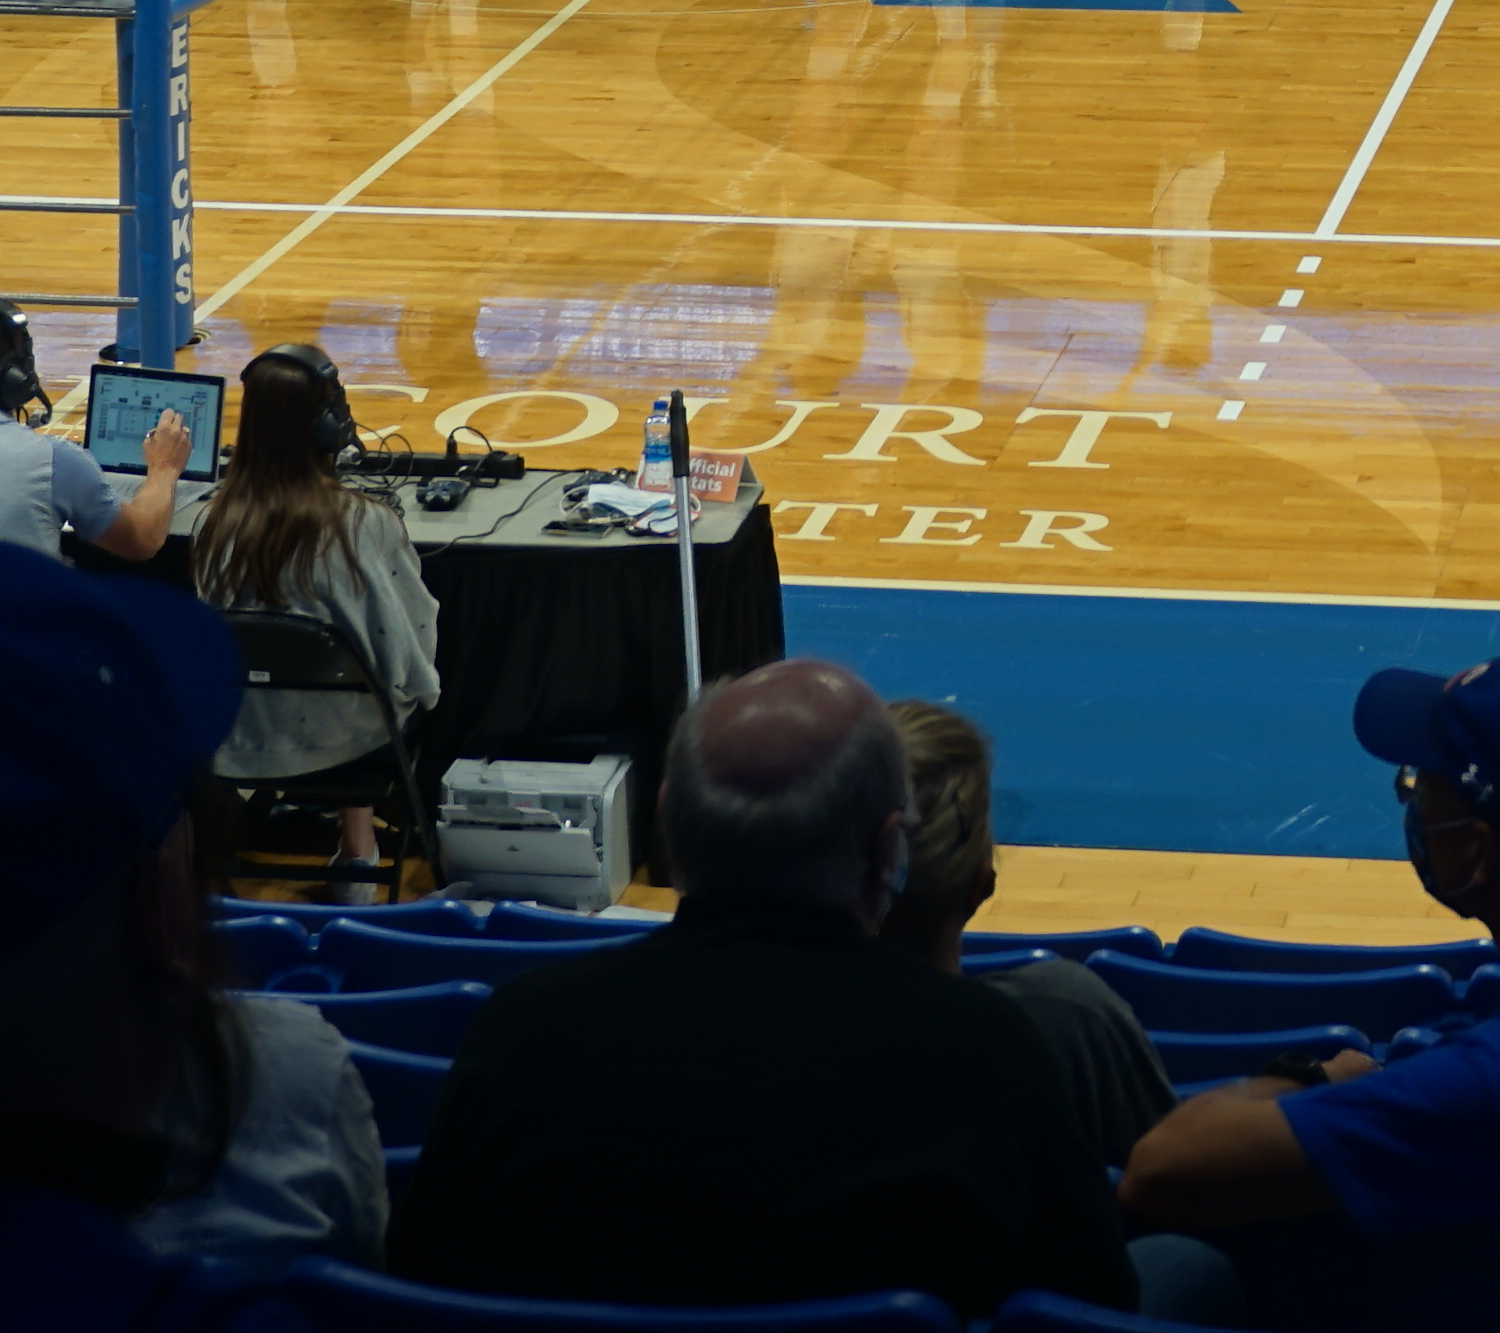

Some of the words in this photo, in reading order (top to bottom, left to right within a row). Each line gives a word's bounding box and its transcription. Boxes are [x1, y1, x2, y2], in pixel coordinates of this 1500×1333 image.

[689, 457, 737, 478] fficial
[690, 477, 723, 493] tats
[776, 500, 1114, 552] TER
